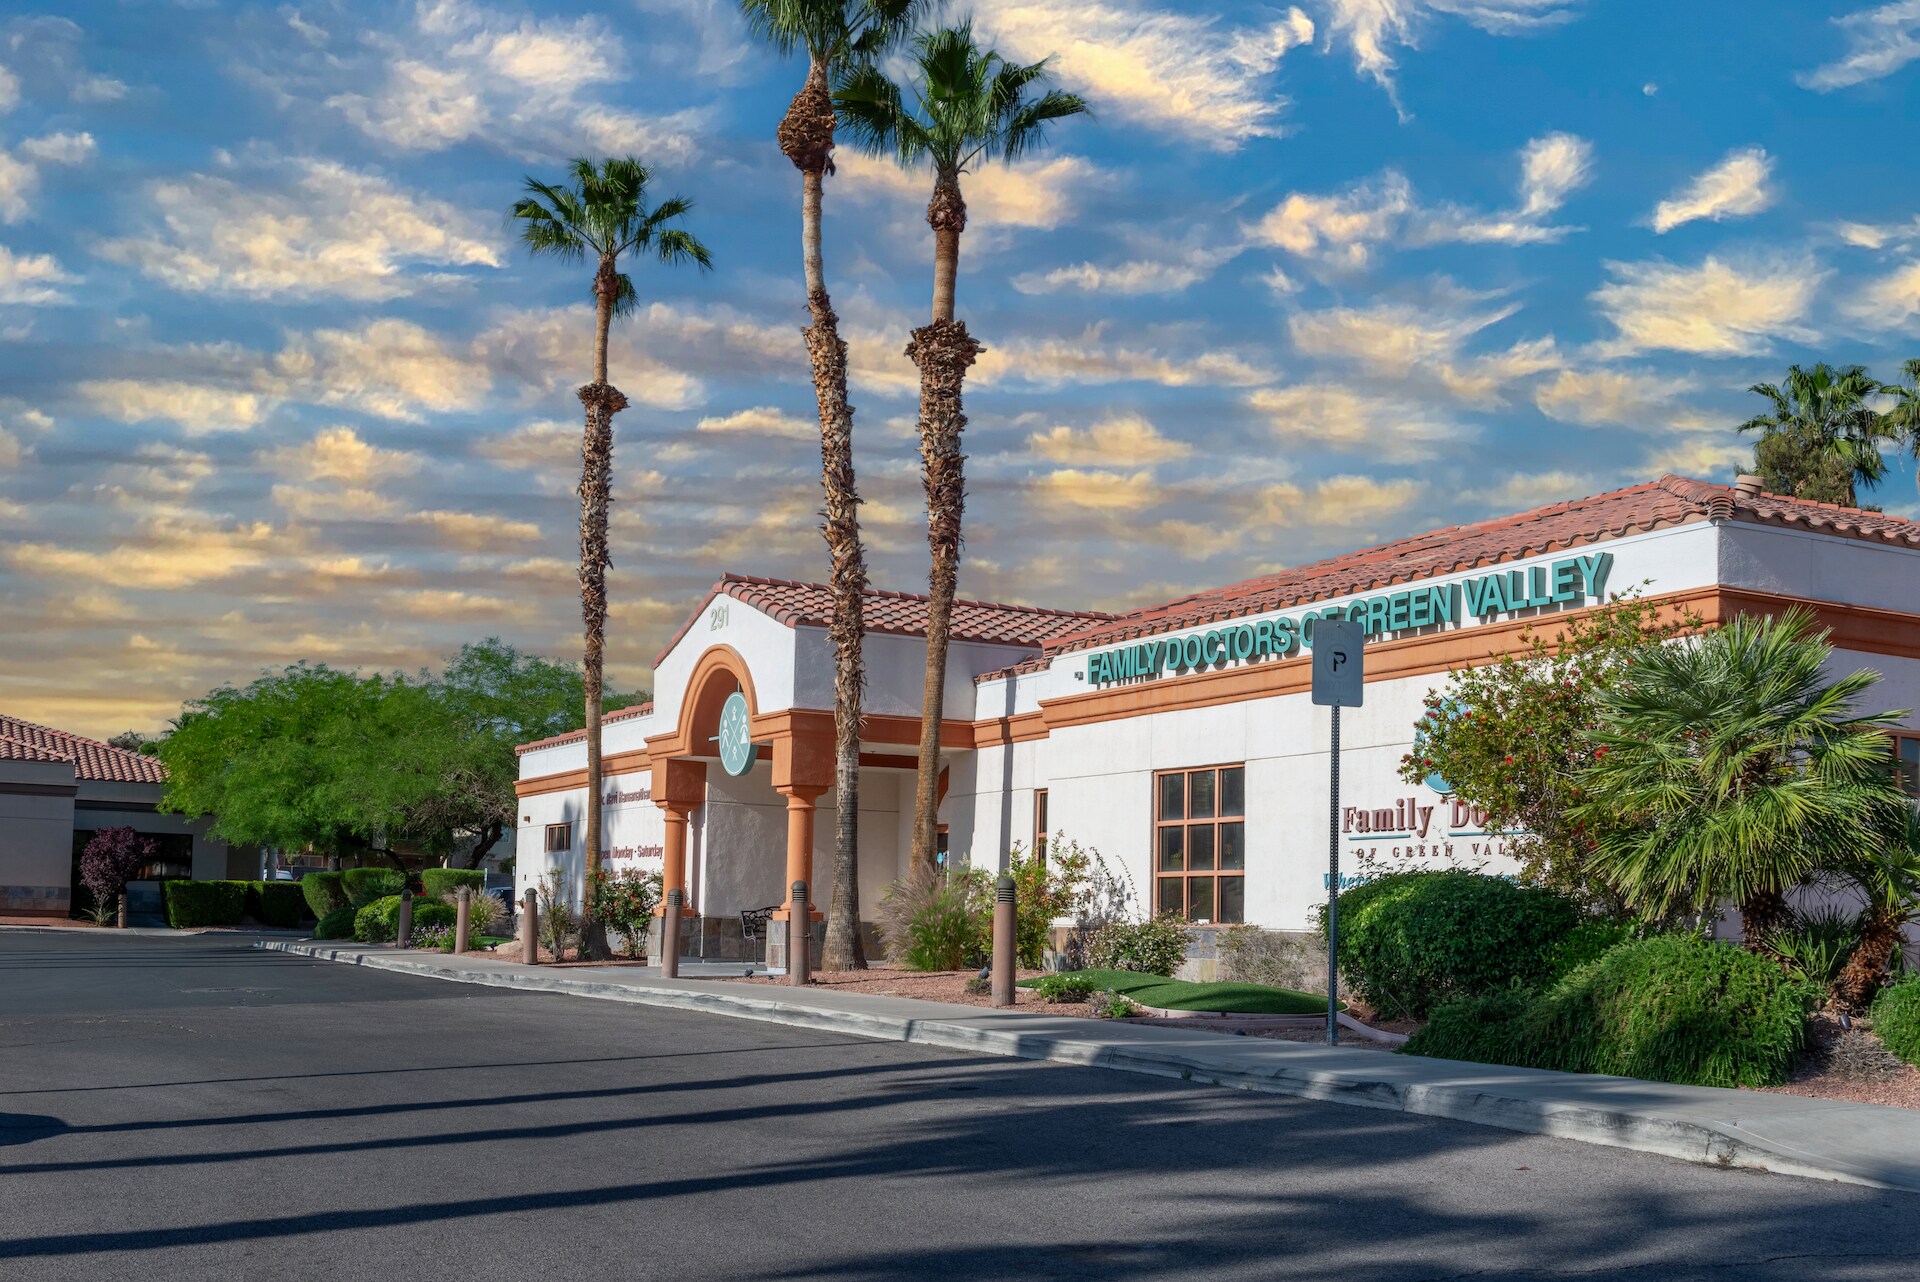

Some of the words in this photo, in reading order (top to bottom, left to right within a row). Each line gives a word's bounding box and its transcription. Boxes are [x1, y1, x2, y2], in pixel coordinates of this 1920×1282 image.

[710, 604, 729, 631] 291
[1088, 640, 1163, 684] FAMILY
[1166, 616, 1295, 670] DOCTORS
[1345, 583, 1457, 635] GREEN
[1462, 552, 1612, 617] VALLEY
[1342, 797, 1434, 838] Family
[637, 844, 663, 859] Saturday
[1356, 847, 1377, 859] OF
[1392, 844, 1454, 858] GREEN
